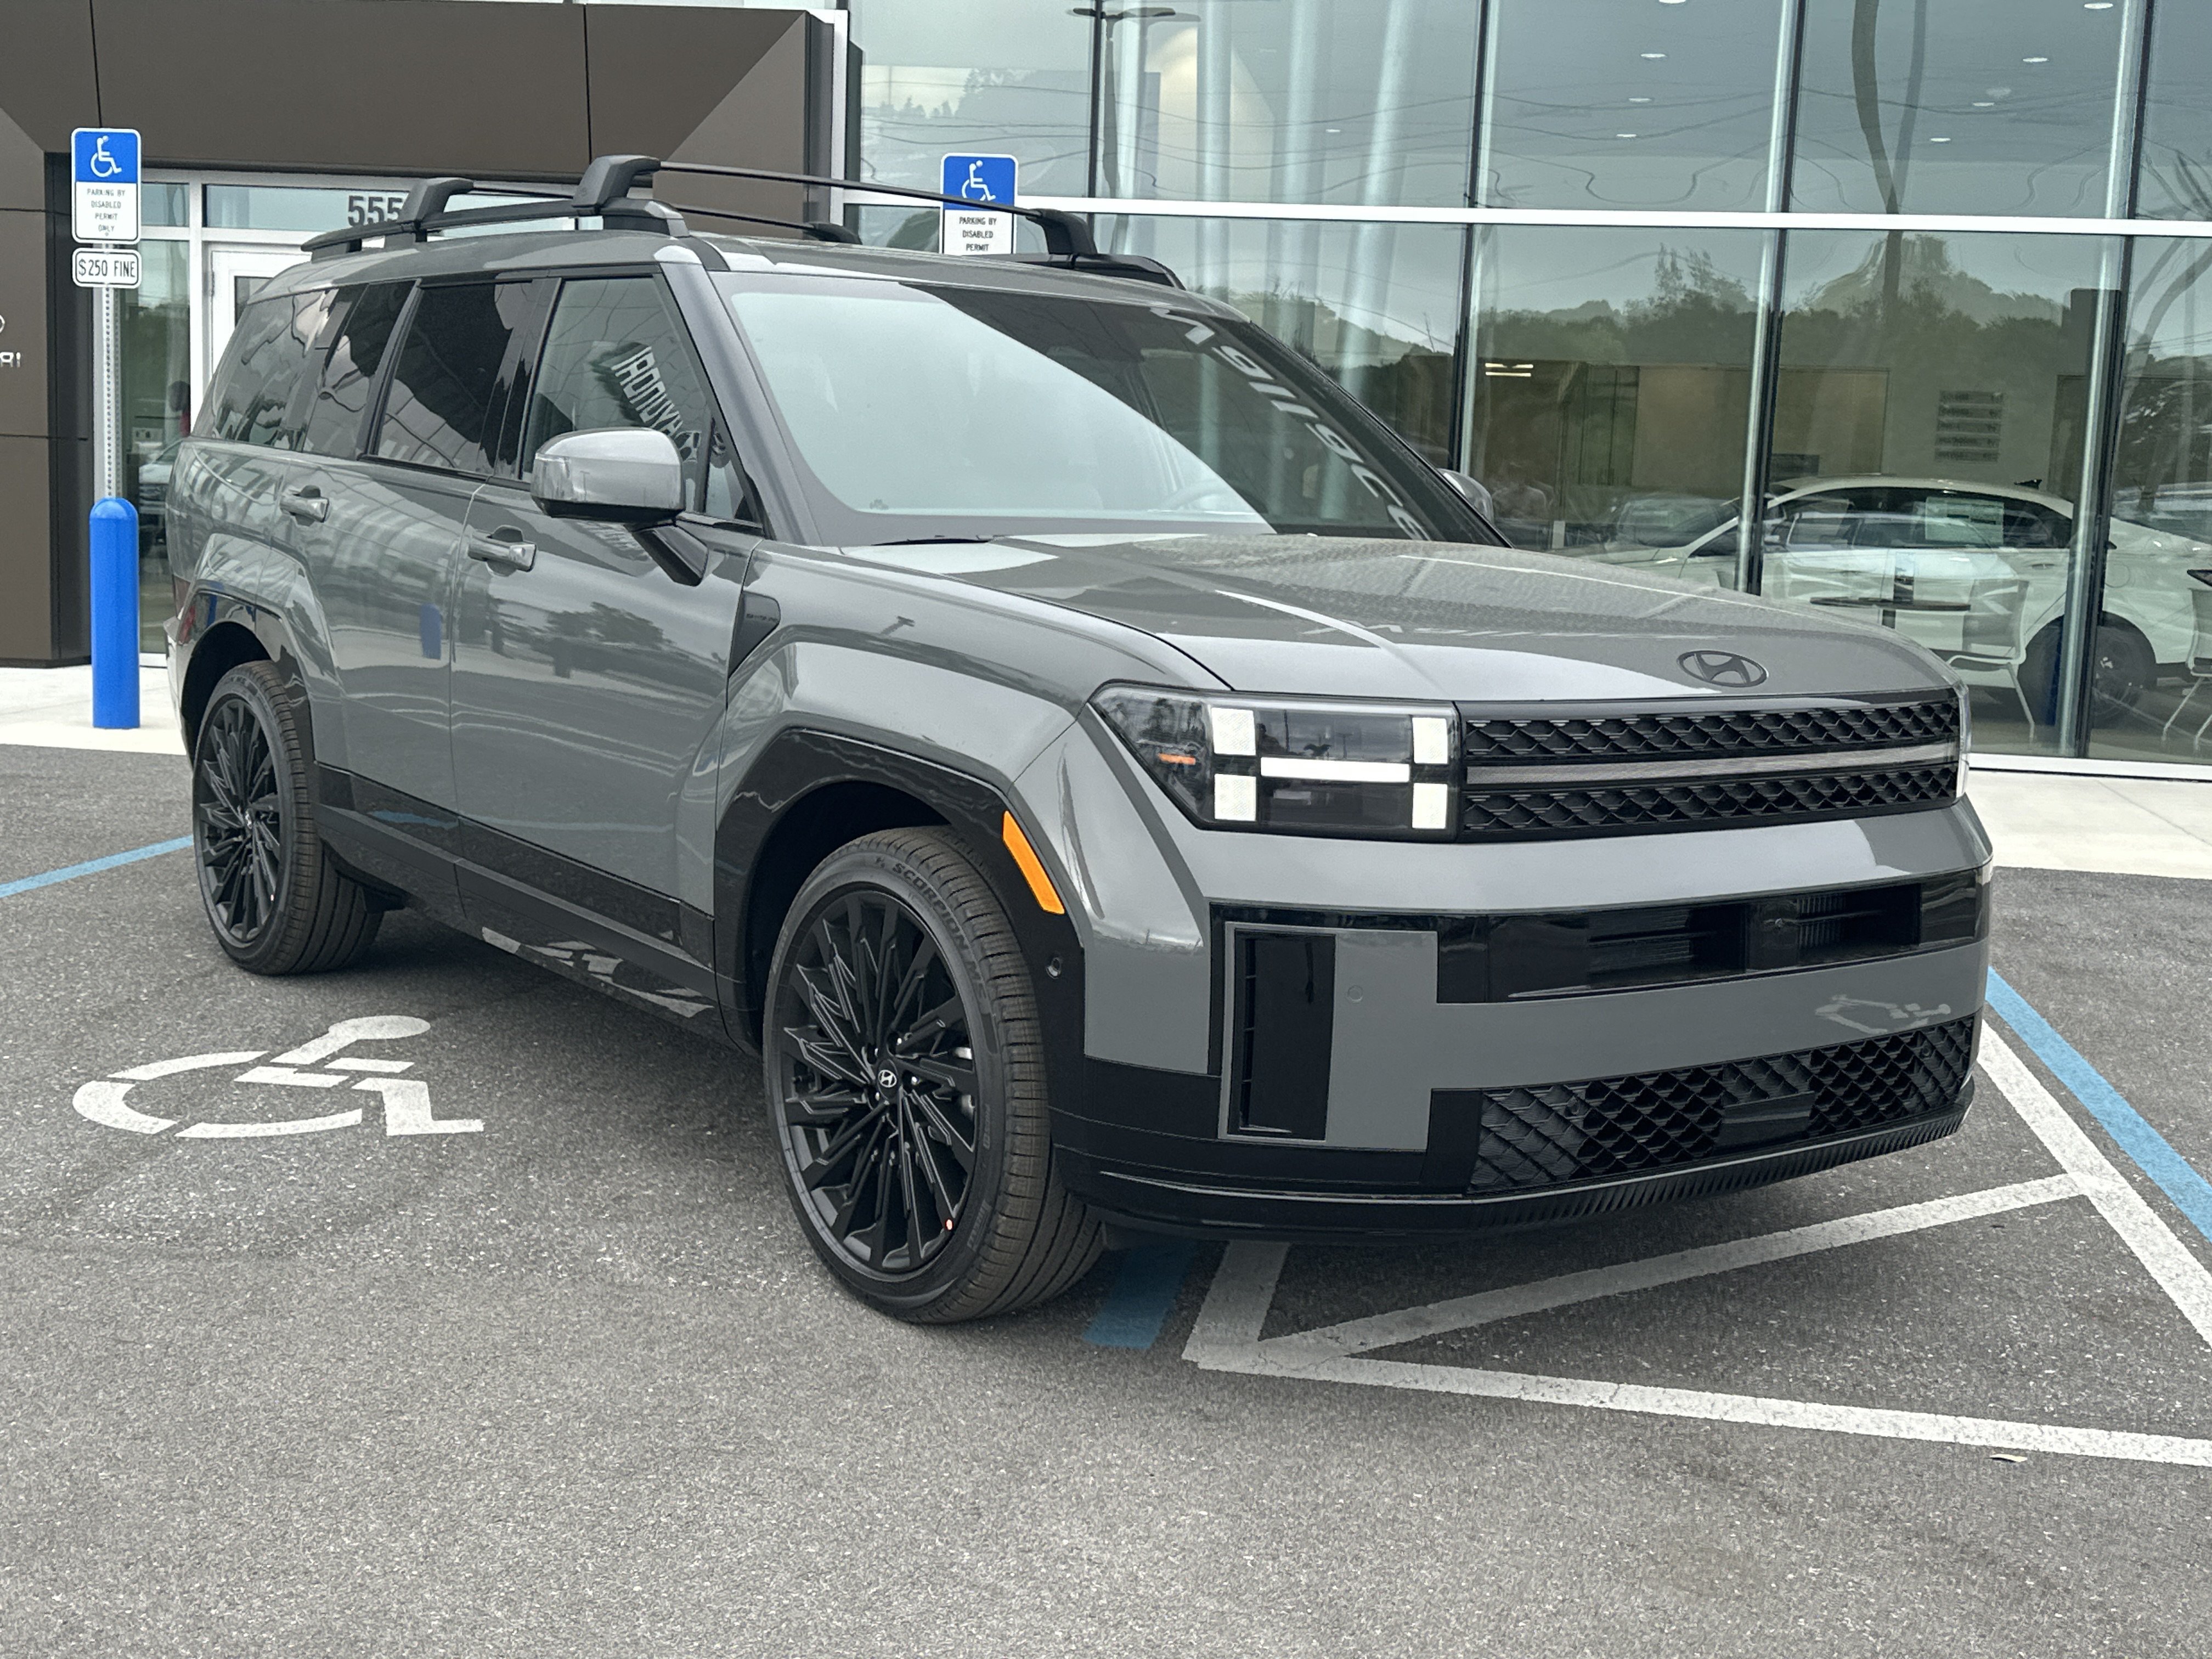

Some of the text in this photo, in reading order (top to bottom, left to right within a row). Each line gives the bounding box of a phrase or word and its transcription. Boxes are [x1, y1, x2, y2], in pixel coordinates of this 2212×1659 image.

[87, 188, 114, 196] PARKING
[91, 200, 121, 208] DISABLED
[94, 212, 118, 221] PERMIT
[959, 216, 997, 225] PARKING BY
[98, 224, 115, 233] ONLY
[962, 229, 994, 239] DISABLED
[966, 243, 989, 252] PERMIT
[78, 258, 136, 278] $250 FINE
[892, 862, 969, 949] SCORPION
